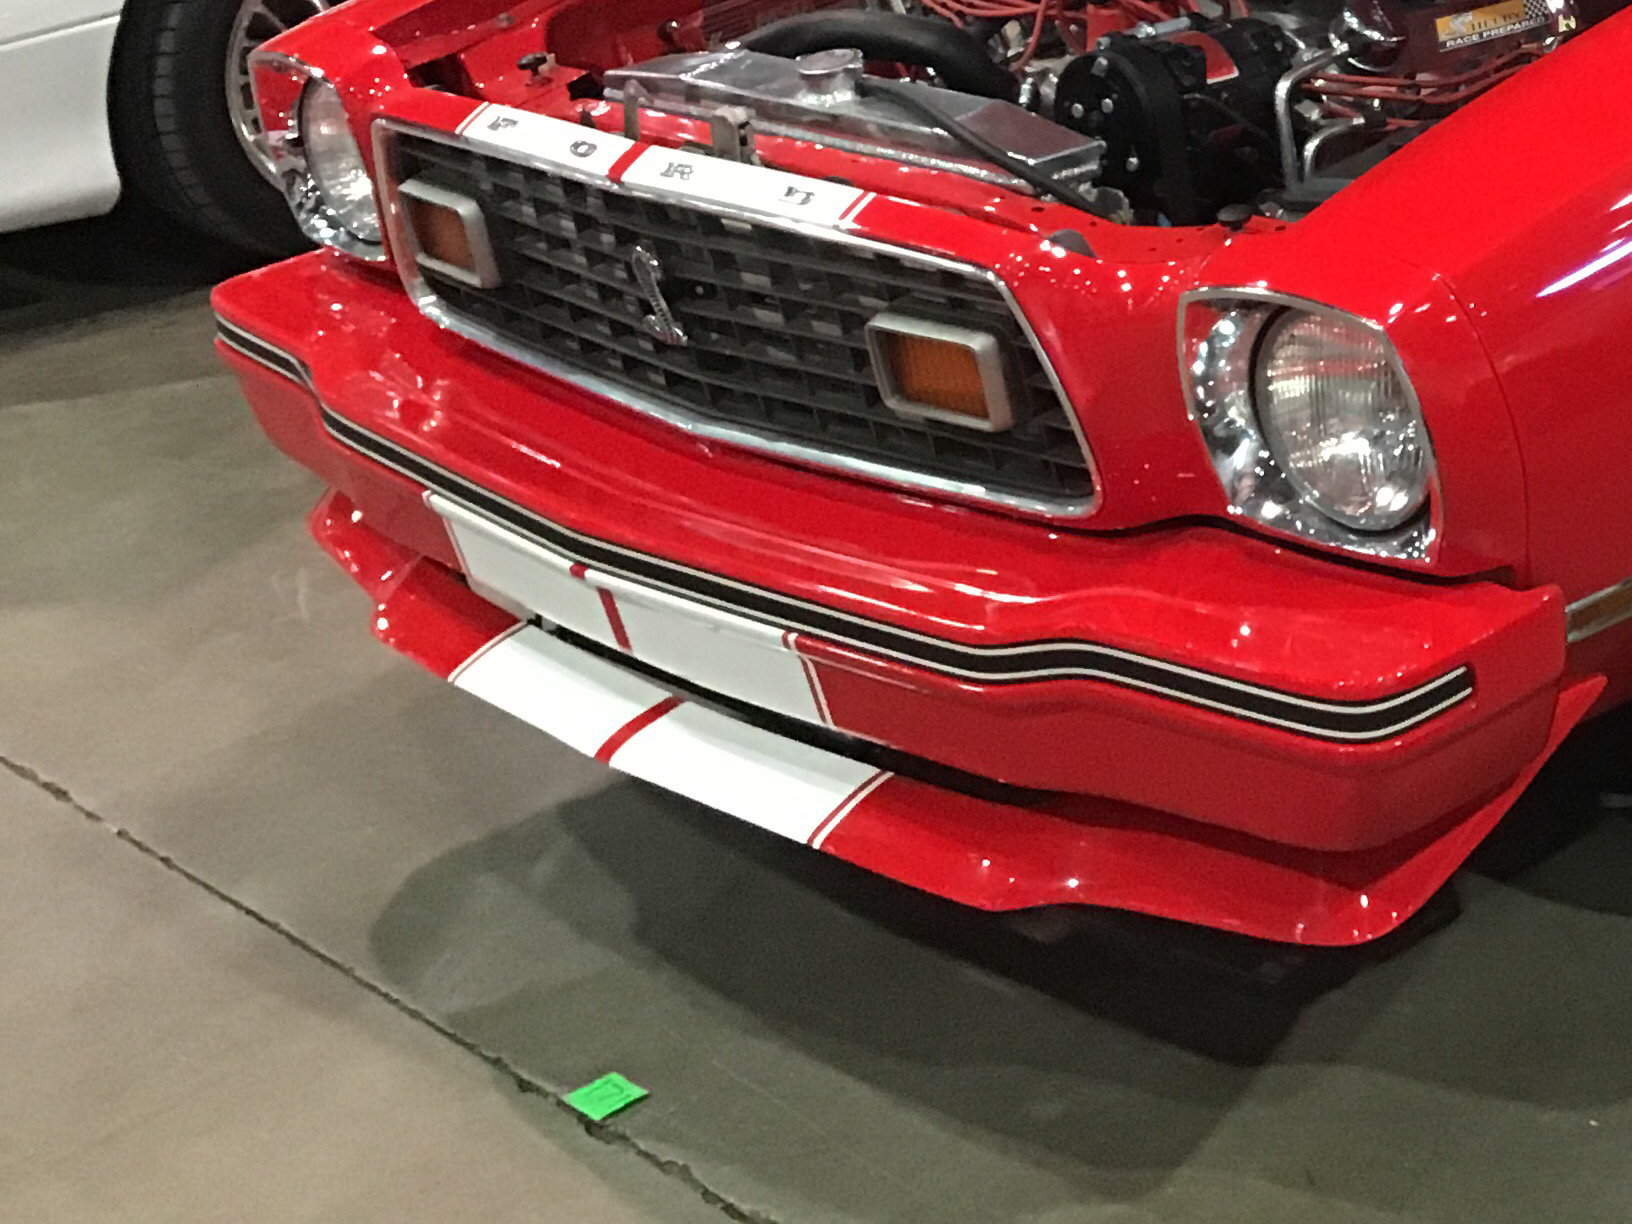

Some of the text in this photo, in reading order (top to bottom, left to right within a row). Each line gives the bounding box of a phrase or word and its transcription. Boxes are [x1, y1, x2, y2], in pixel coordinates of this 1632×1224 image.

[1446, 16, 1546, 48] RACE PREPARED
[487, 115, 816, 206] FORD
